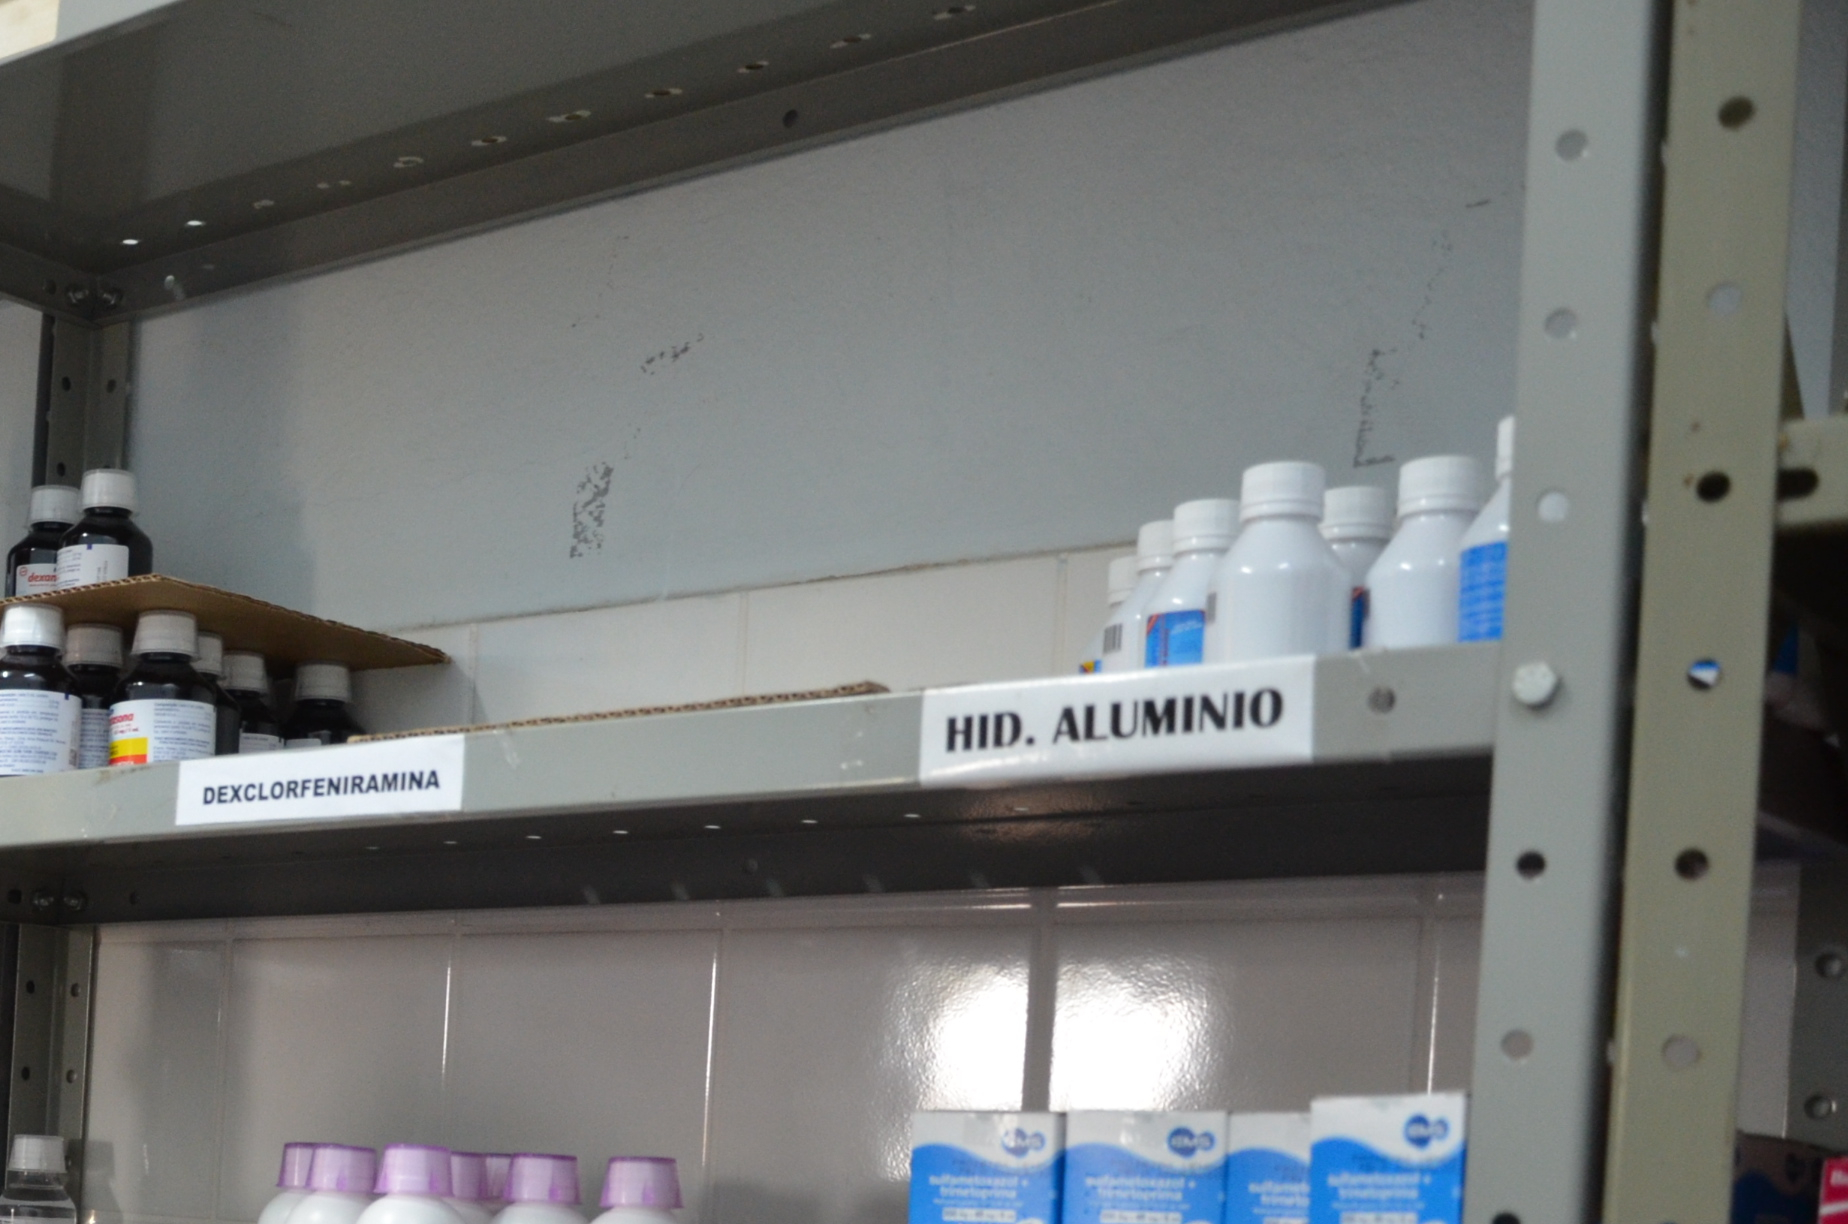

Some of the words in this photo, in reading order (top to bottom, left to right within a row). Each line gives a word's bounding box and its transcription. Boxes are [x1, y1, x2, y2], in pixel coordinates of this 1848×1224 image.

[947, 712, 1034, 751] HID.
[1053, 688, 1283, 744] ALUMINIO
[203, 770, 440, 805] DEXCLORFENIRAMINA
